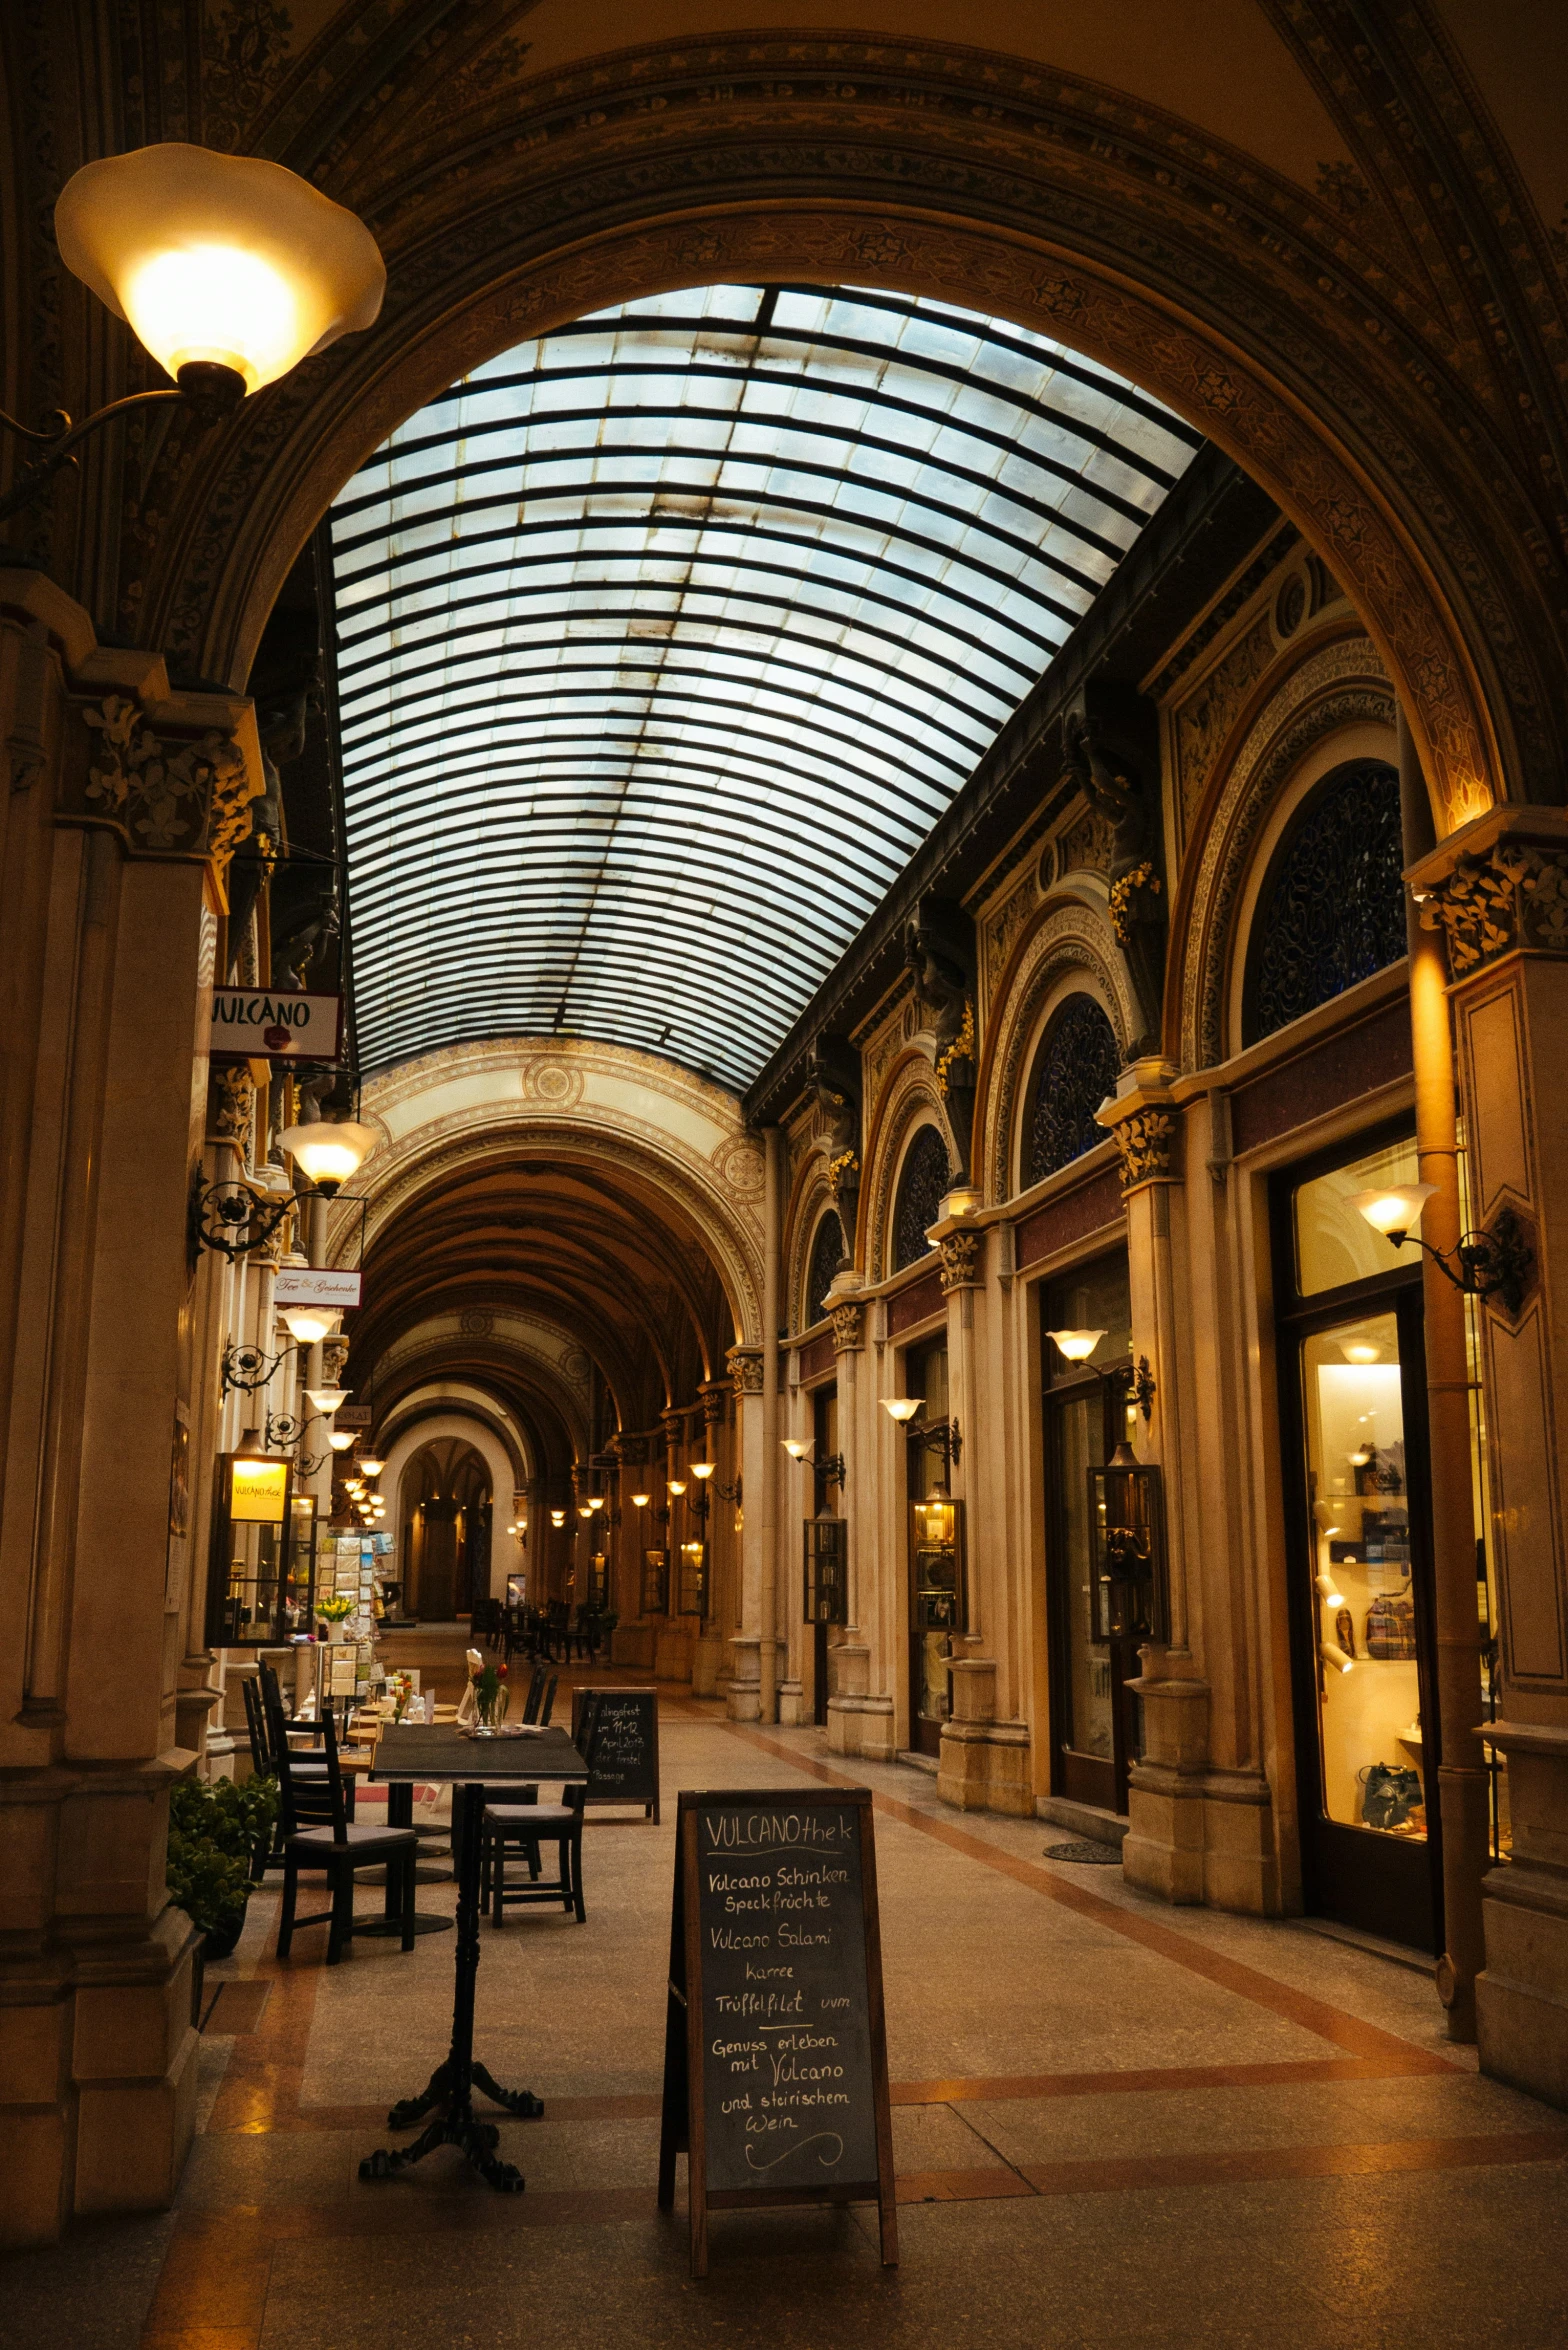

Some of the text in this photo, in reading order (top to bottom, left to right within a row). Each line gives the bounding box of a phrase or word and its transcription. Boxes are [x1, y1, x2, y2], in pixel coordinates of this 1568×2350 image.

[708, 1864, 849, 1893] Vulcano Schinken
[724, 1890, 831, 1915] Speckfrüchte
[711, 1922, 832, 1949] Vulcano Salami
[715, 1989, 804, 2018] Trüffelfilet
[711, 2033, 839, 2058] Genuss erleben
[730, 2053, 844, 2087] mit Vulcano
[721, 2087, 851, 2114] und steirischem
[745, 2113, 799, 2133] Wein
